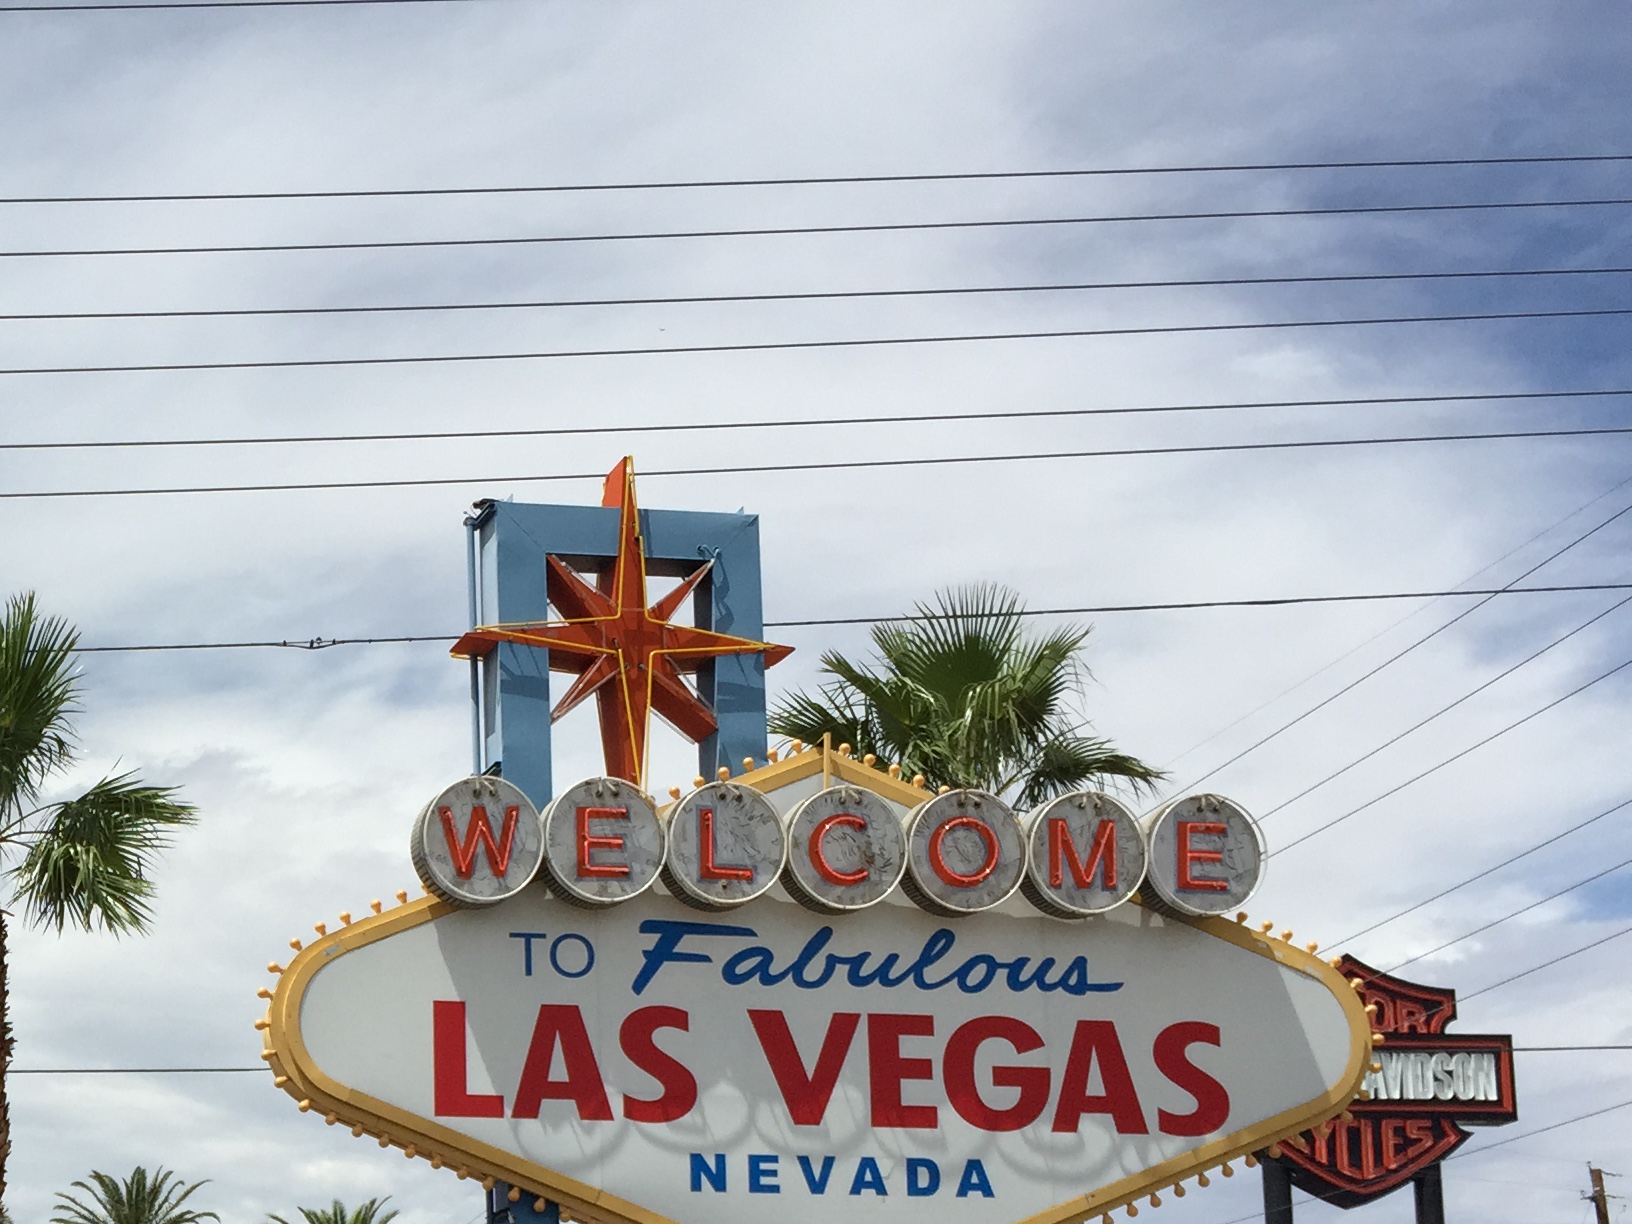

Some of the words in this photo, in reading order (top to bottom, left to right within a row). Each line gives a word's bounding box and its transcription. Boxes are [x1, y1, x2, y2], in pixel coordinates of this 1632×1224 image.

[437, 804, 1229, 892] WELCOME
[509, 932, 596, 978] TO
[632, 919, 1124, 996] Fabulous
[432, 1000, 698, 1123] LAS
[746, 1010, 1231, 1138] VEGAS
[1354, 1051, 1498, 1101] AVIDSON
[689, 1152, 995, 1198] NEVADA
